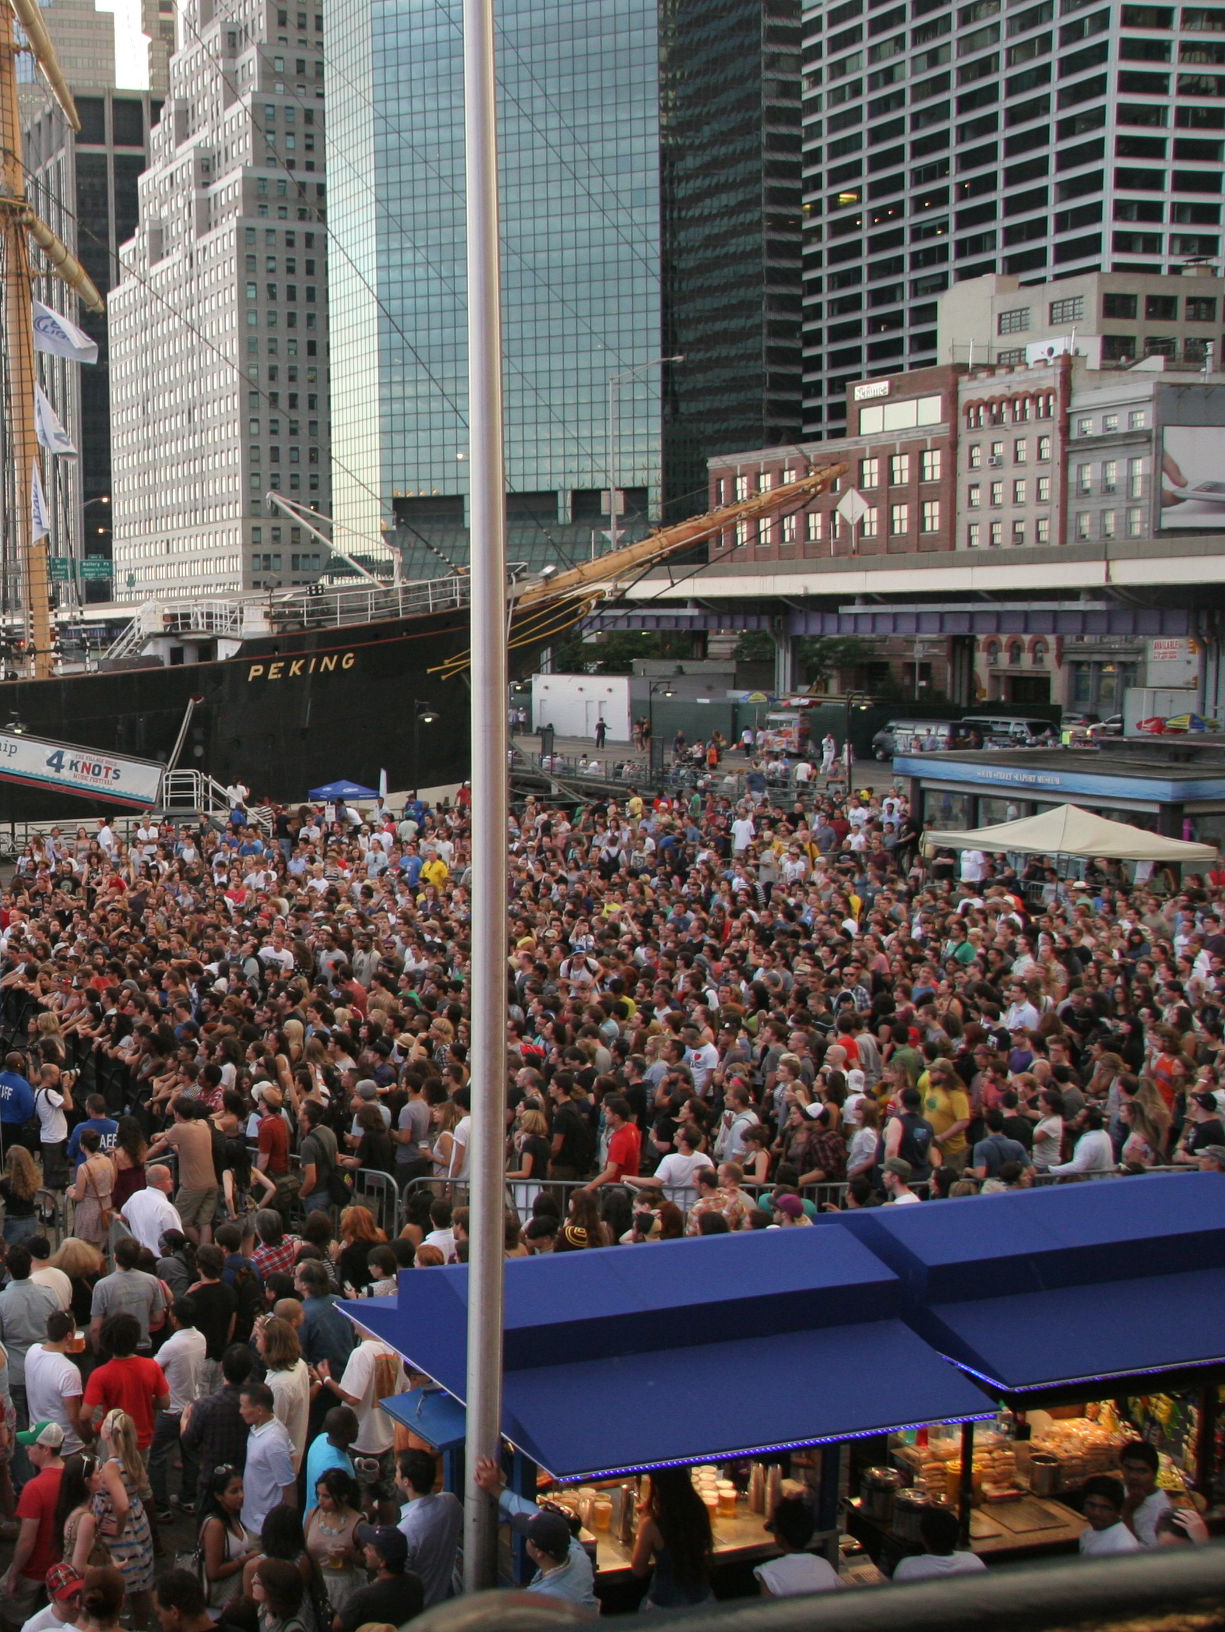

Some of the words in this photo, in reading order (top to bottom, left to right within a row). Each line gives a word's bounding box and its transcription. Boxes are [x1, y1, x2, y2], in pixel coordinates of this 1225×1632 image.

[247, 652, 355, 682] PEKING
[46, 750, 65, 773] 4
[69, 760, 121, 780] KNOTS
[99, 1133, 118, 1148] AFF
